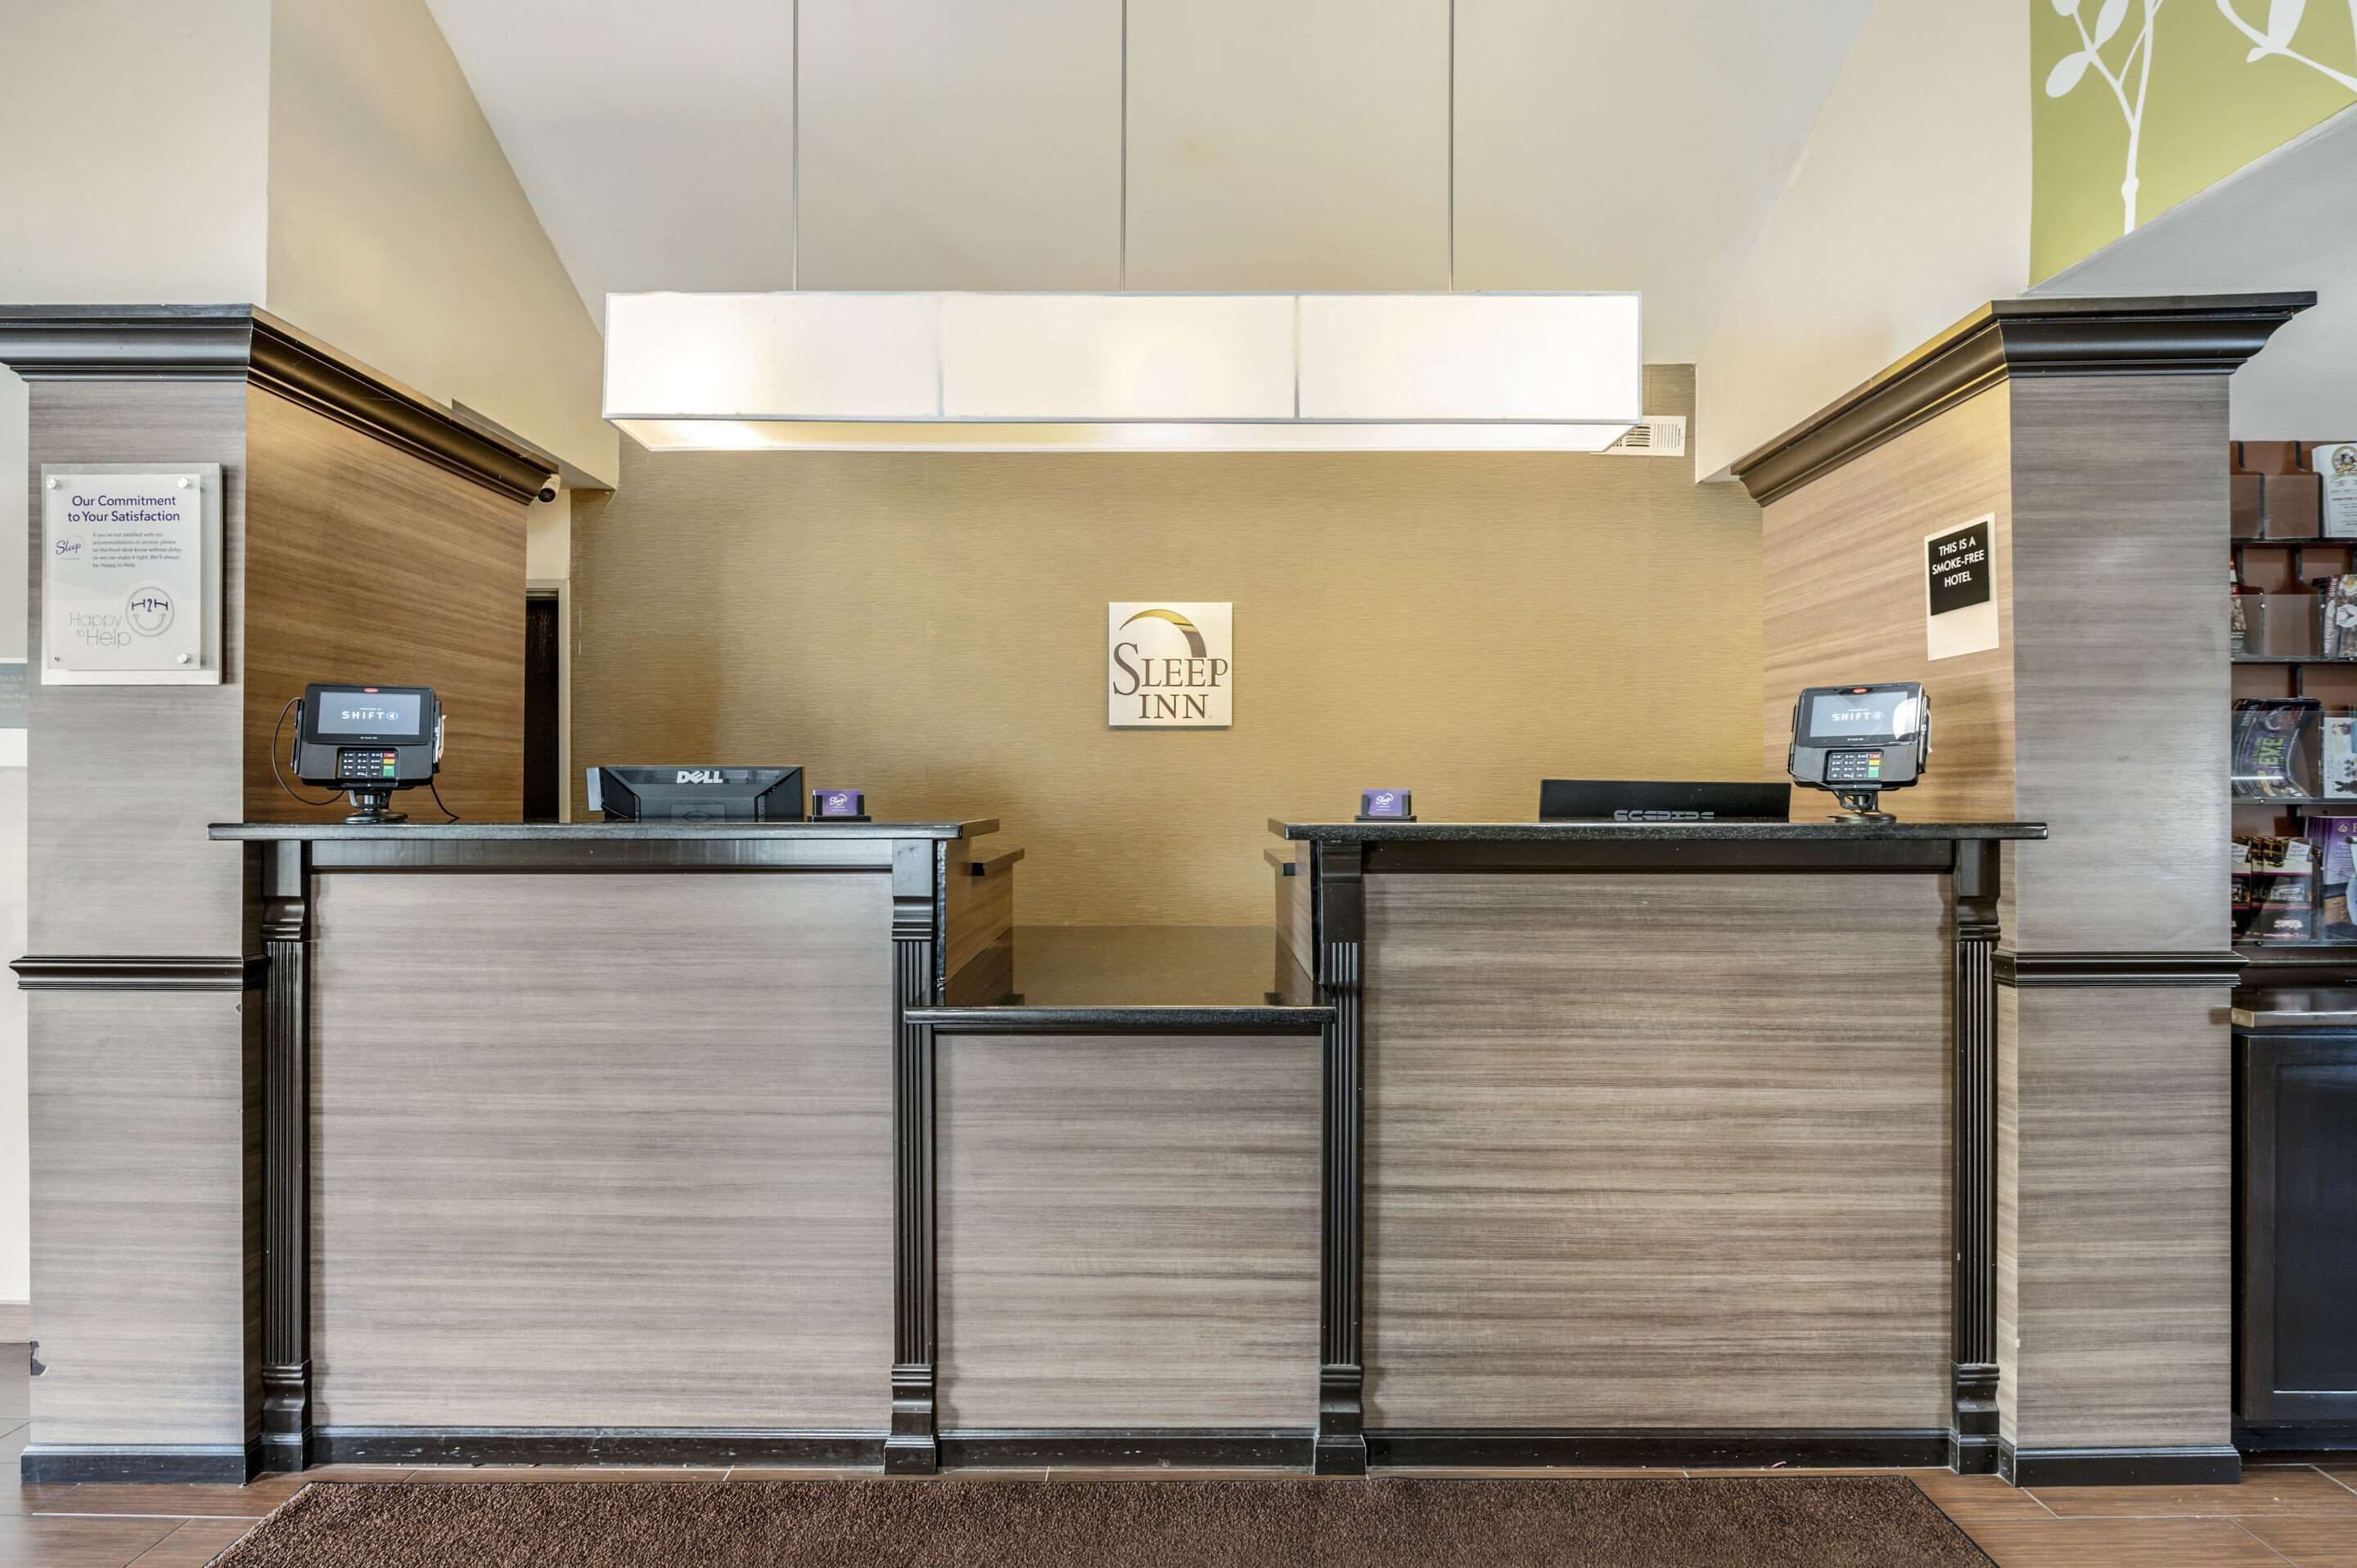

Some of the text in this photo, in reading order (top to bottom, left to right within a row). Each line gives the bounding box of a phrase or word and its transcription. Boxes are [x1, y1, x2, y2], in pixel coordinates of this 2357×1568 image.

[72, 494, 177, 507] Our Commitment
[68, 510, 180, 522] to Your Satisfaction
[55, 539, 82, 556] Sleep
[1937, 536, 1976, 556] THIS IS A
[1931, 549, 1985, 575] SMOKE-FREE
[1944, 570, 1972, 588] HOTEL
[70, 611, 123, 629] Happy
[76, 629, 132, 649] to Help
[1113, 642, 1228, 696] SLEEP
[1138, 694, 1210, 719] INN
[676, 770, 723, 784] DELL
